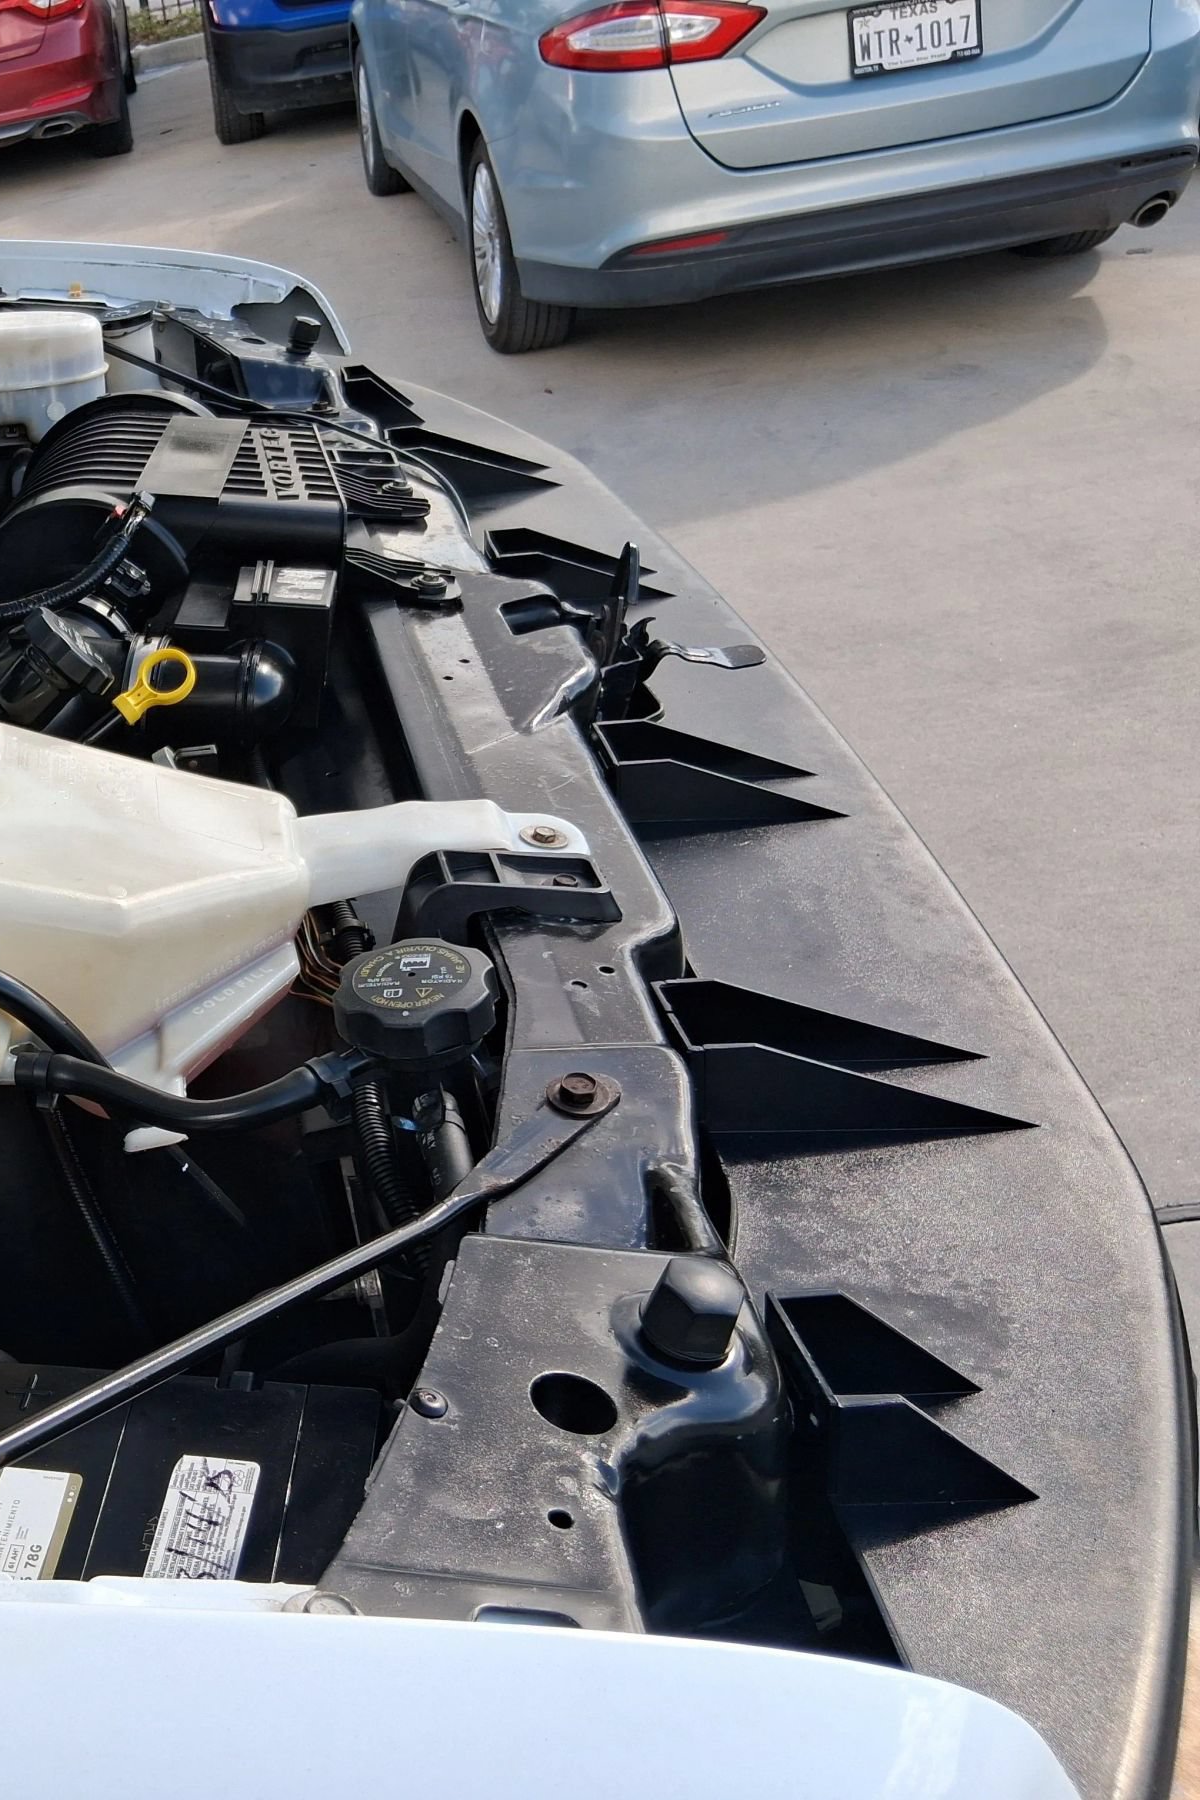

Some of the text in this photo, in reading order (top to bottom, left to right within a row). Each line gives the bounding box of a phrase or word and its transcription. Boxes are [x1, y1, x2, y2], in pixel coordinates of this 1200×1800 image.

[889, 2, 938, 20] TEXAS
[260, 428, 300, 500] VORTEC
[192, 967, 273, 1015] COLD FILL
[25, 1544, 42, 1568] 78G
